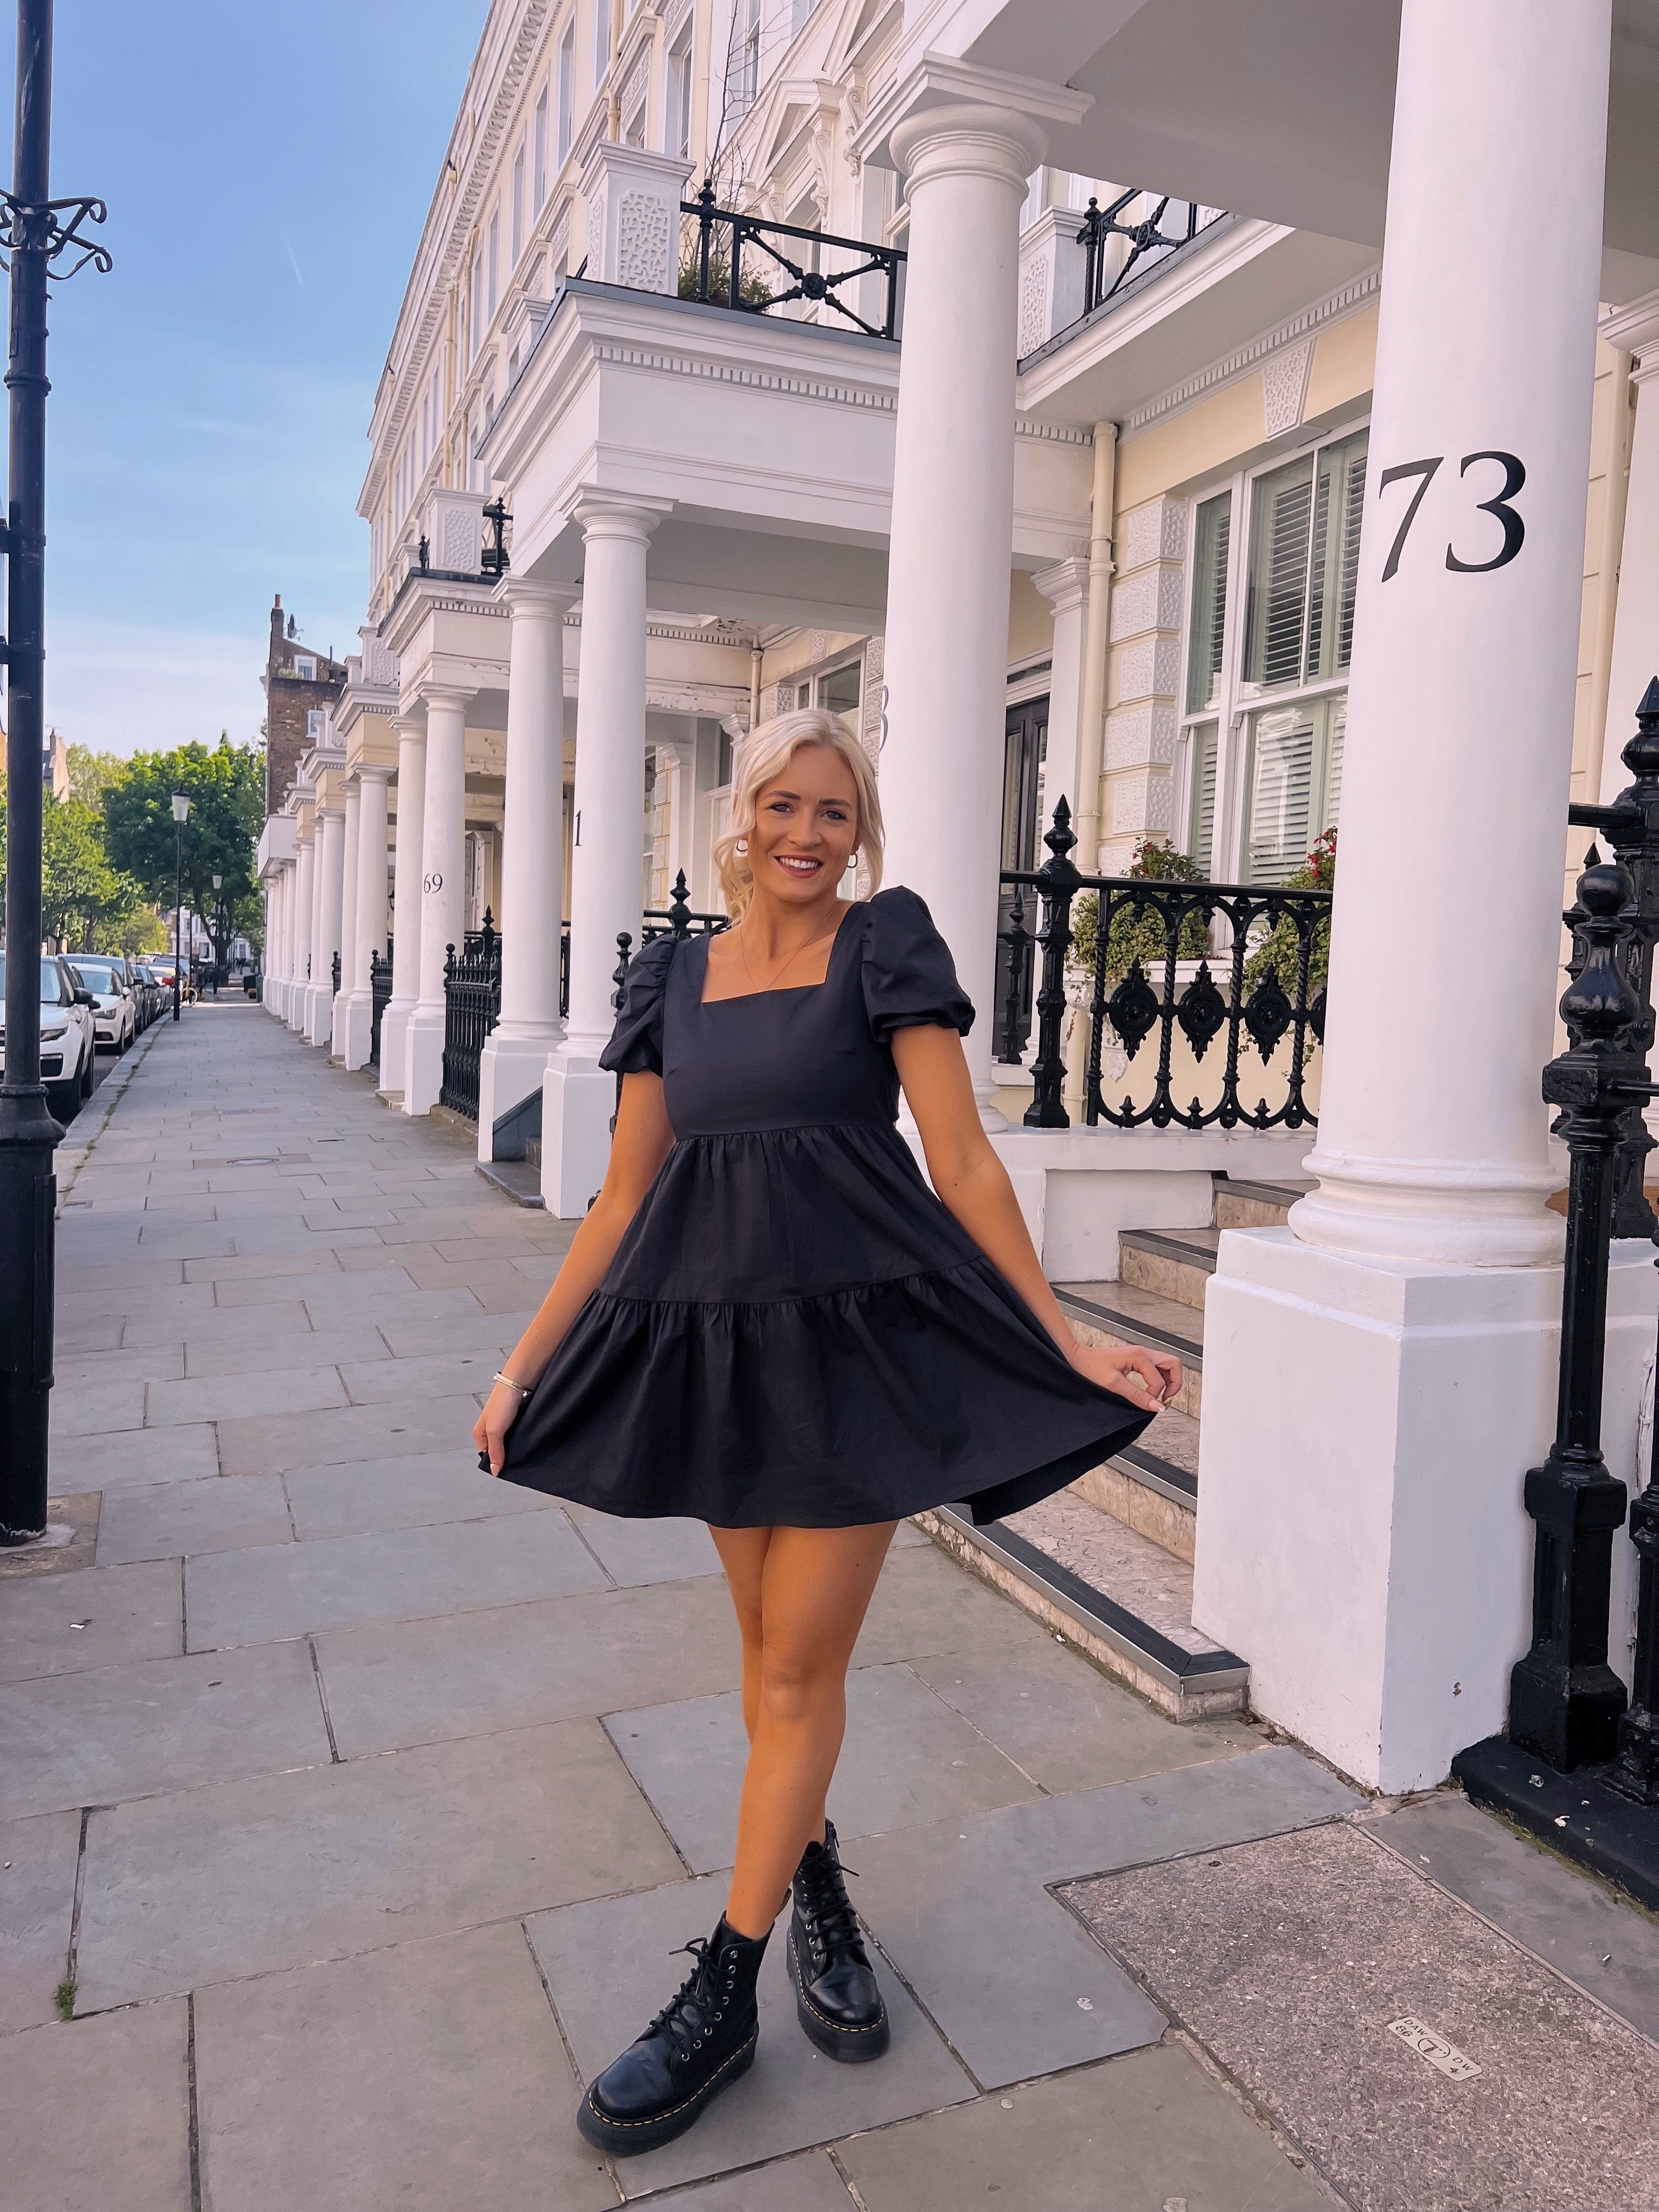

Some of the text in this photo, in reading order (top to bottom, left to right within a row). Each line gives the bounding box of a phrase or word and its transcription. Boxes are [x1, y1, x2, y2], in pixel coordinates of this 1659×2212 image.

[1379, 450, 1526, 583] 73
[424, 873, 443, 893] 69
[1403, 2019, 1429, 2035] DAW
